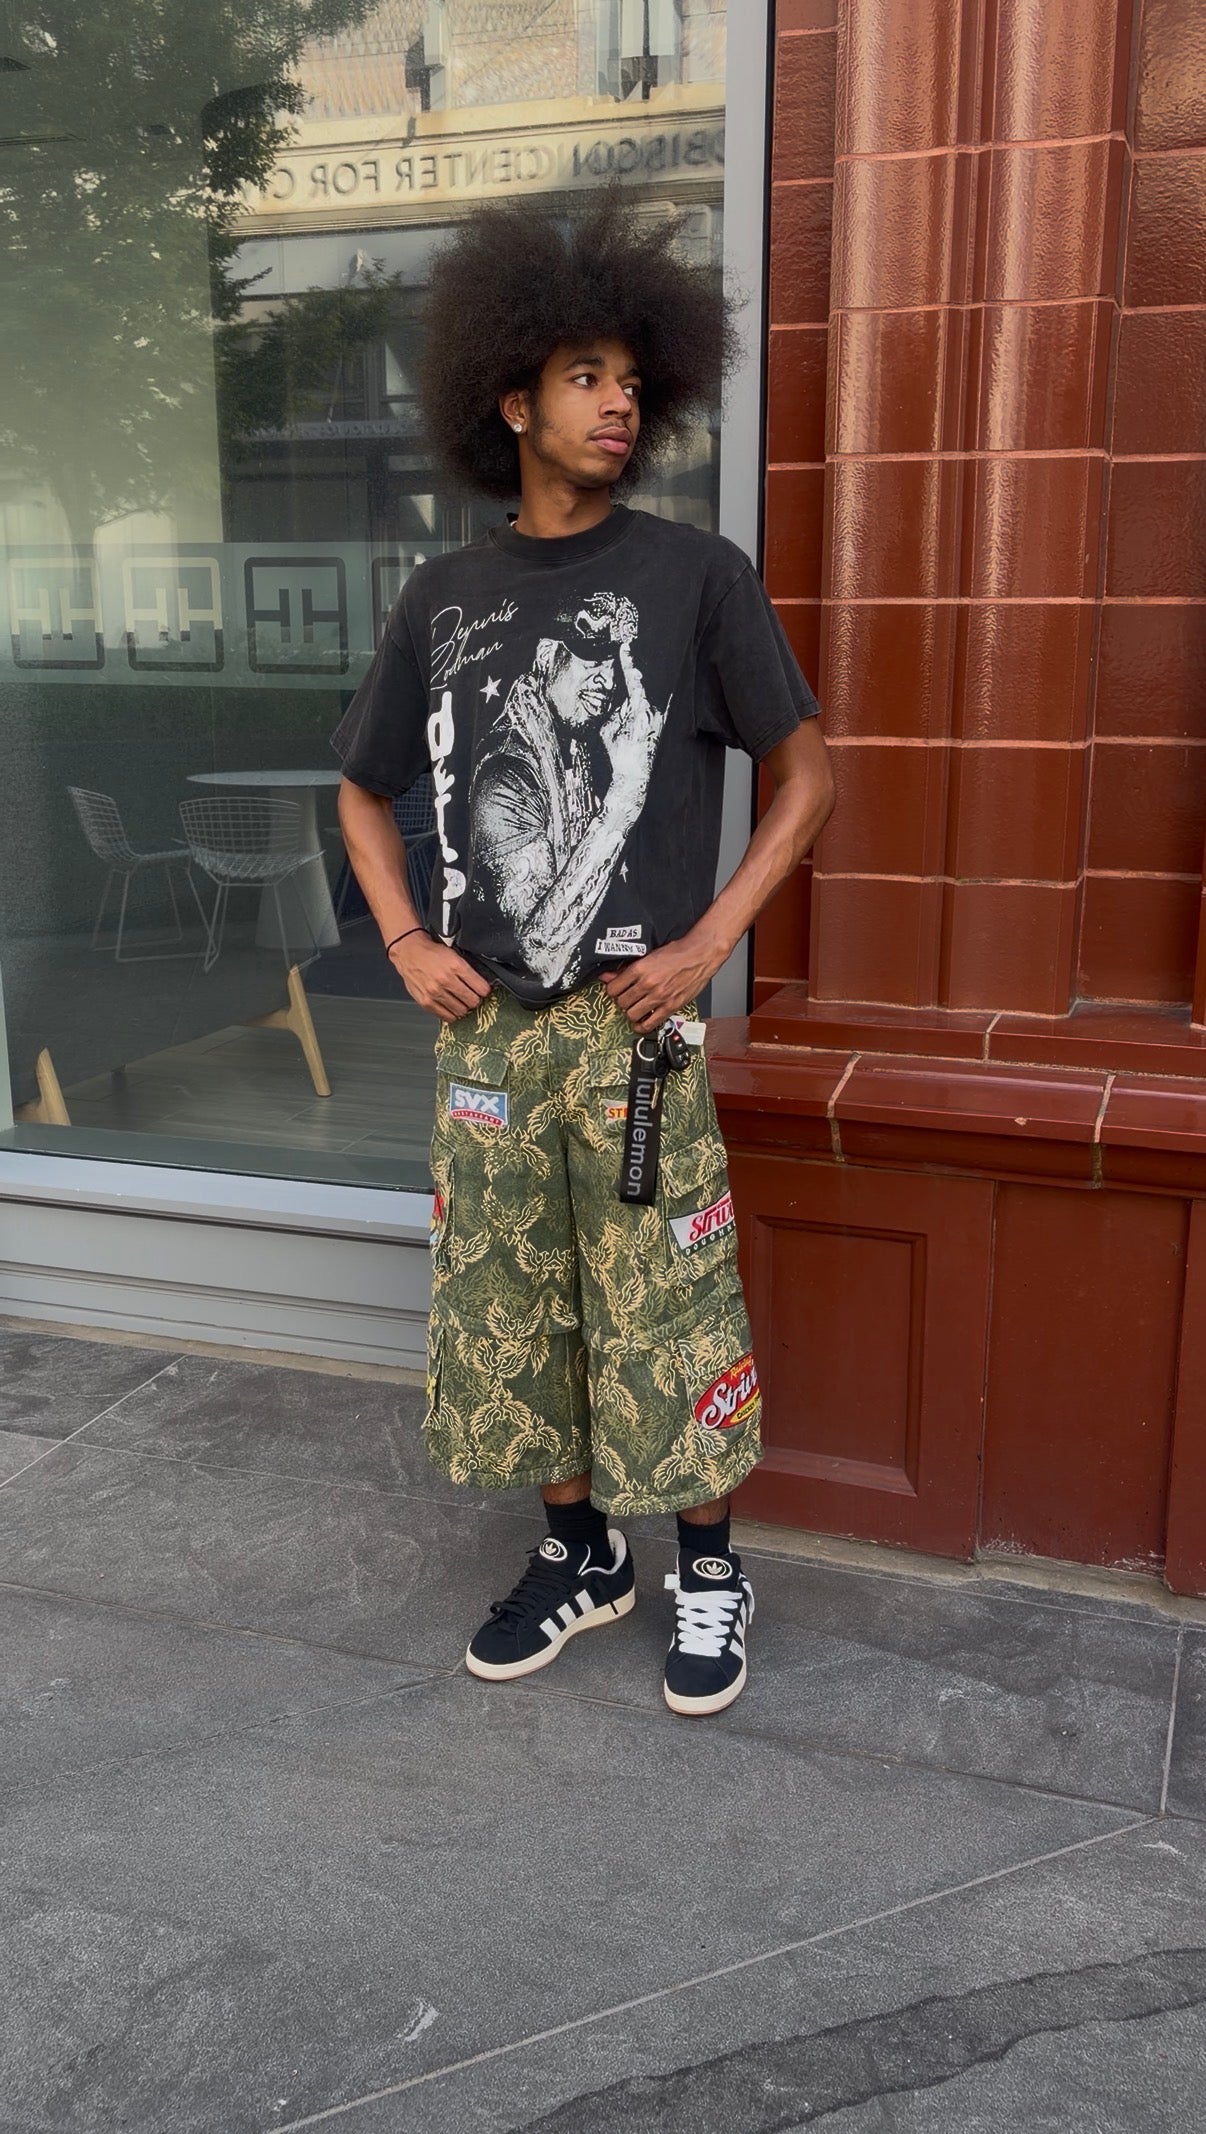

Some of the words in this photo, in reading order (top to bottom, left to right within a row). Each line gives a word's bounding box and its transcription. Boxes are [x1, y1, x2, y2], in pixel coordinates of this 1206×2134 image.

[609, 929, 627, 938] BAD
[627, 928, 638, 938] AS
[626, 1077, 656, 1197] lululemon
